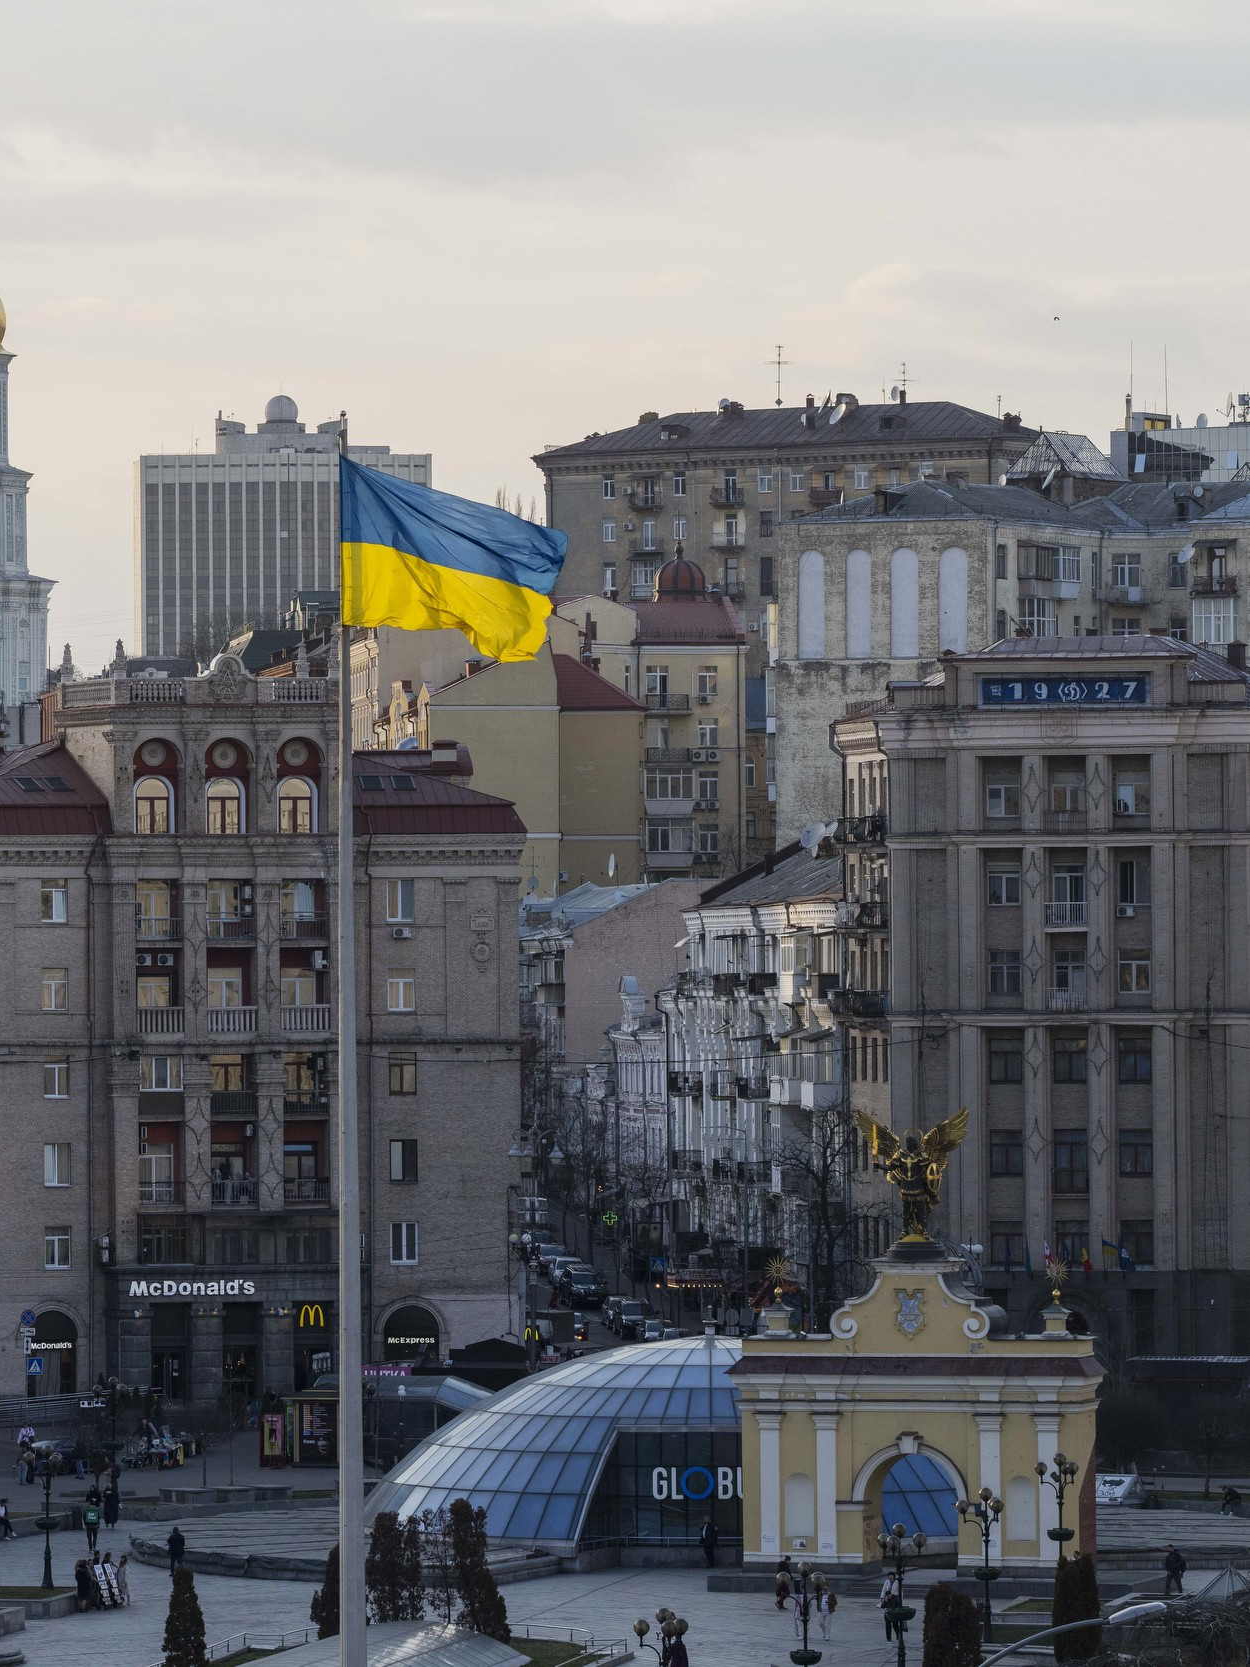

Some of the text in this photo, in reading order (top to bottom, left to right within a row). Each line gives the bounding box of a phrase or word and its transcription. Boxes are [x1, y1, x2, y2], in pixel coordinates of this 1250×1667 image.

[128, 1279, 256, 1297] McDonald's
[387, 1336, 435, 1345] McExpress
[30, 1341, 73, 1350] McDonald's
